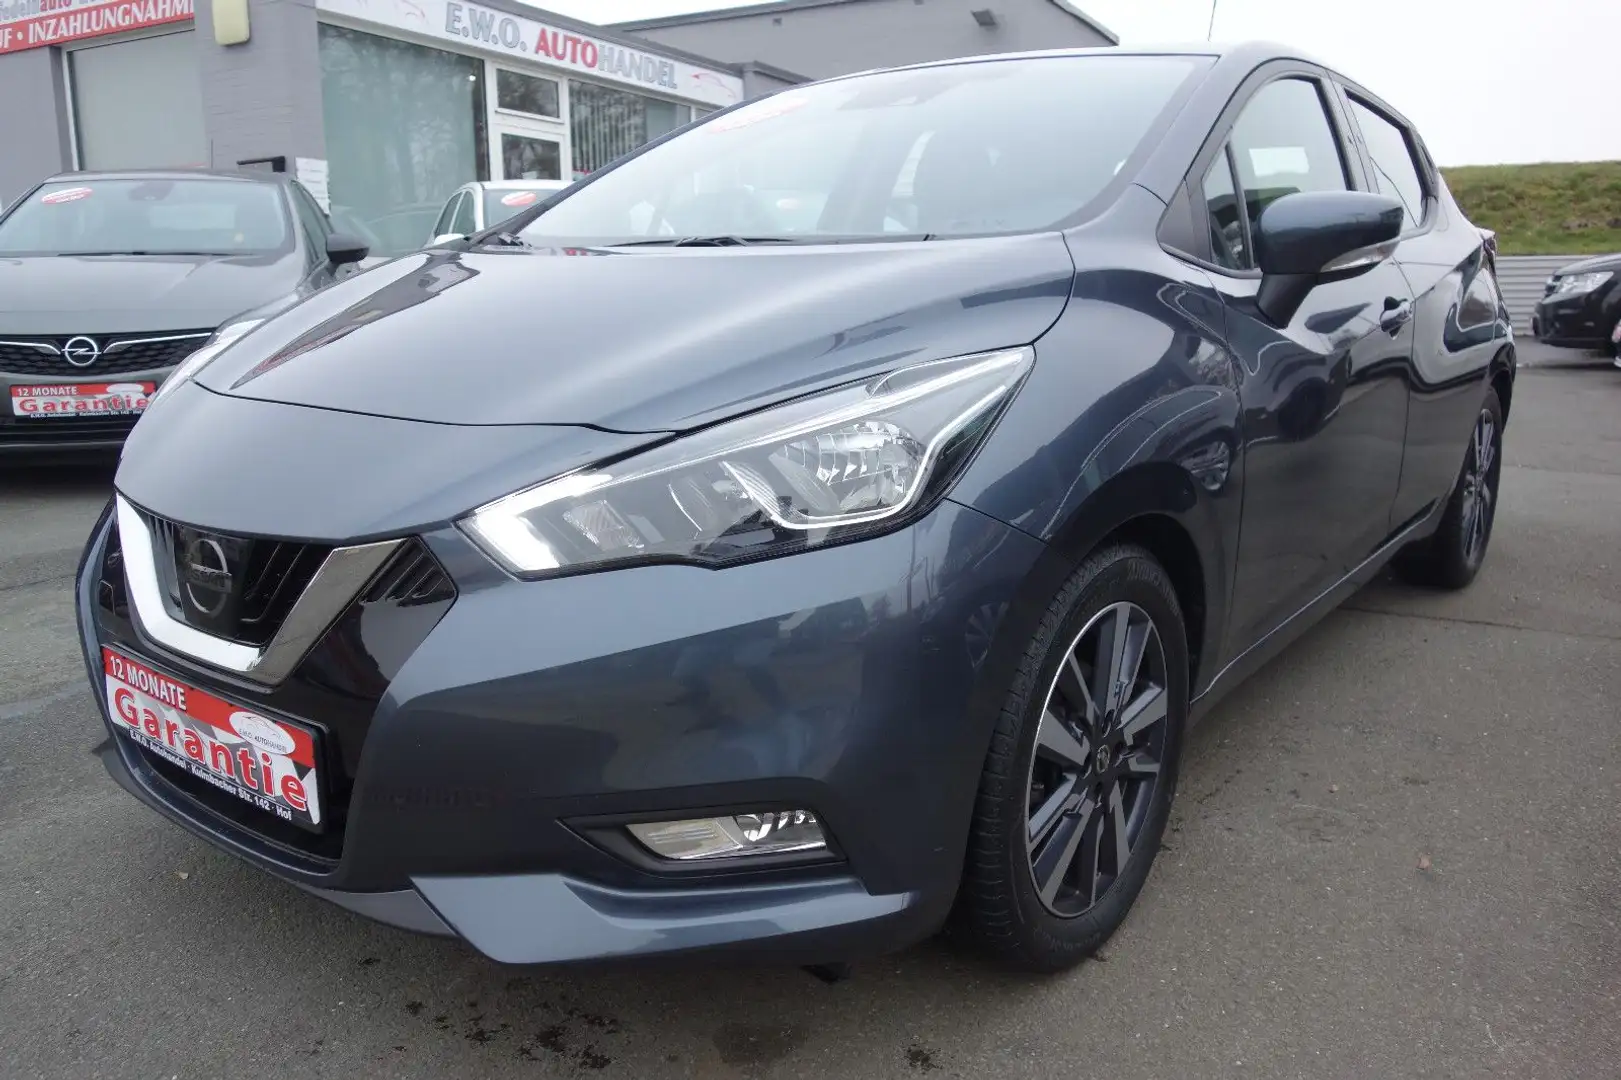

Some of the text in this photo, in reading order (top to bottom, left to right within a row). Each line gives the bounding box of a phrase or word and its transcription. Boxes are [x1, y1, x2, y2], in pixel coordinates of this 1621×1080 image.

[445, 1, 527, 52] E.W.O.
[17, 386, 77, 397] 12 MONATE
[19, 394, 149, 413] Garantie
[110, 655, 187, 711] 12 MONATE
[114, 687, 308, 812] Garantie
[254, 796, 271, 811] 142
[276, 804, 293, 821] Hof
